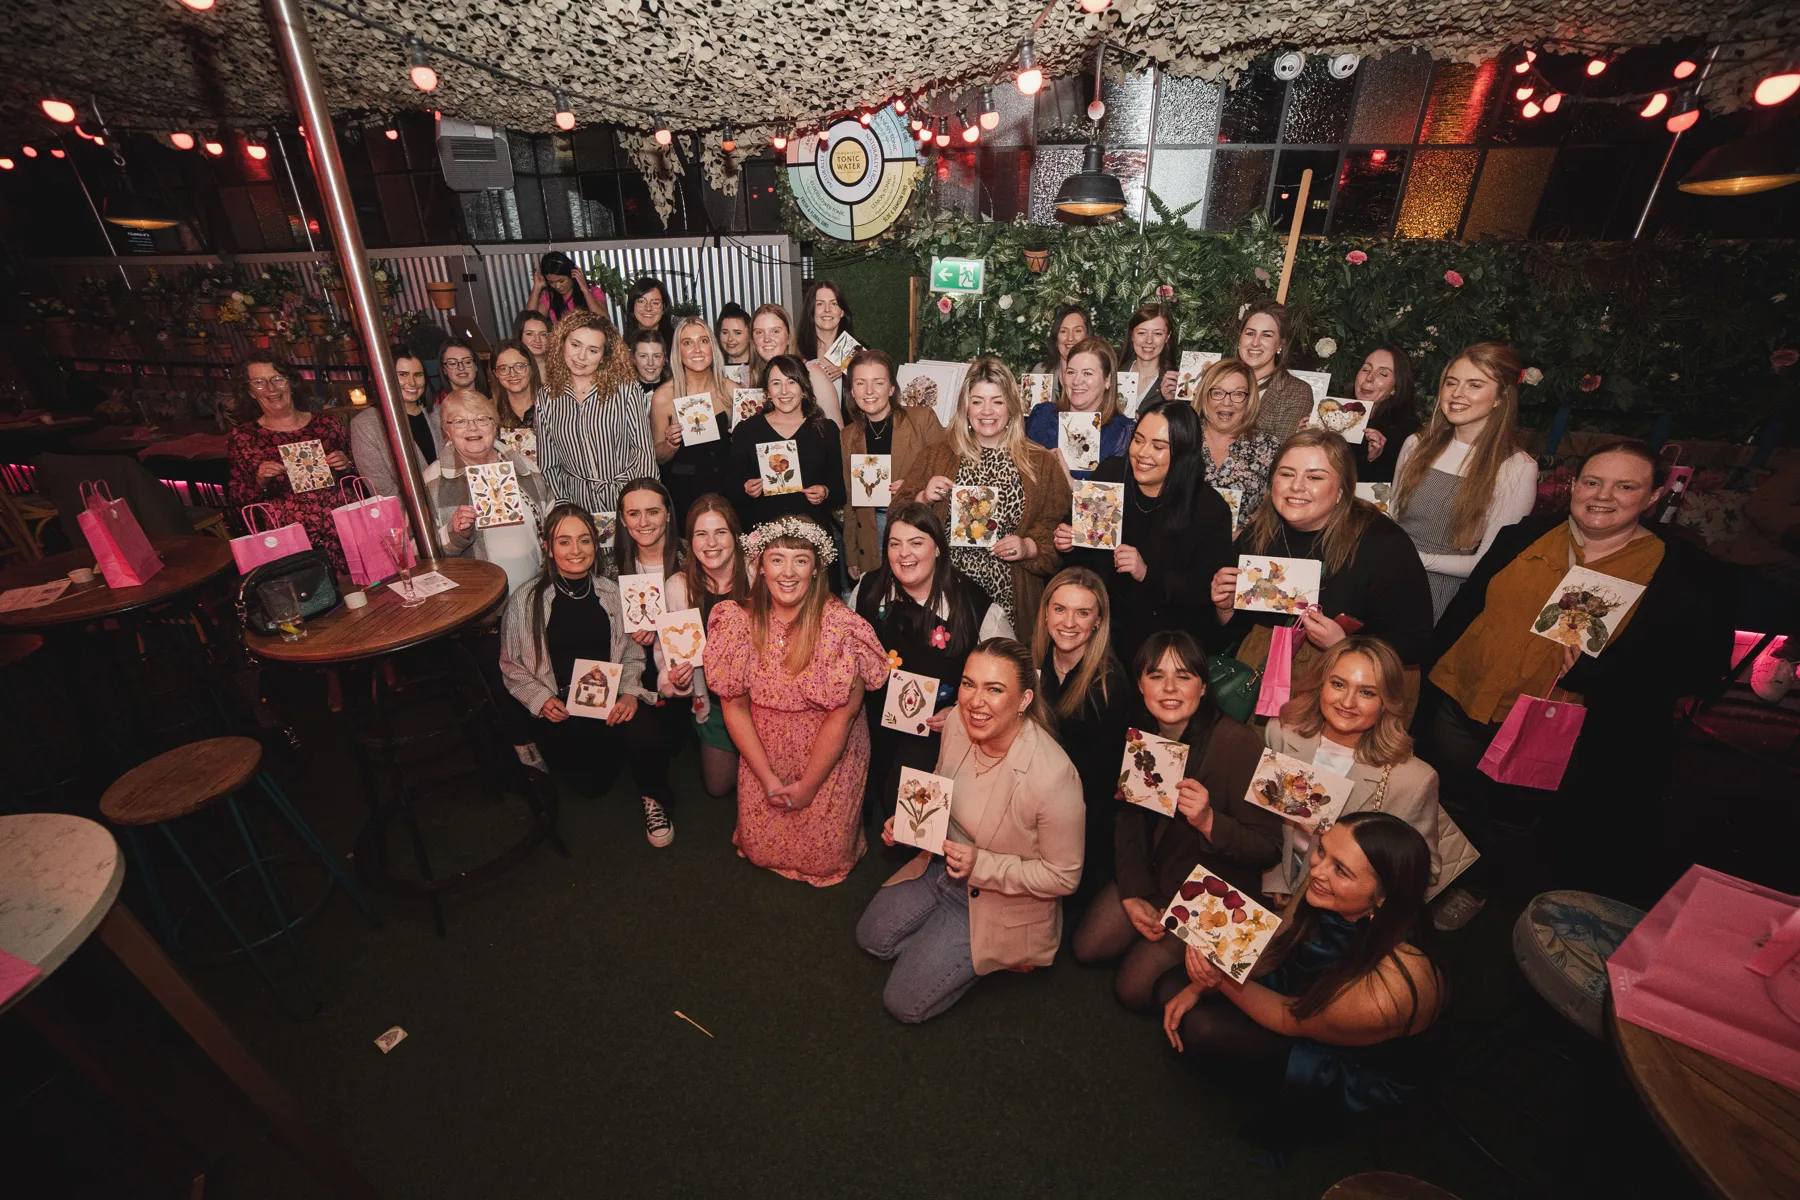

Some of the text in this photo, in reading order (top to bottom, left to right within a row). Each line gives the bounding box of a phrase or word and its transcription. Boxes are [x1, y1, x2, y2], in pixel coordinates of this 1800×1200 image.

[865, 133, 879, 169] NATURALLY
[889, 133, 898, 151] TONIC
[820, 154, 833, 188] NATURALLY
[837, 155, 860, 163] TONIC
[867, 169, 879, 188] LIGHT
[870, 194, 883, 209] LEMON
[882, 177, 892, 195] TONIC
[800, 196, 809, 209] FRESH
[809, 210, 821, 223] FLORAL
[832, 206, 846, 217] TONIC
[882, 213, 892, 223] SLOE
[892, 195, 904, 212] DAMSON
